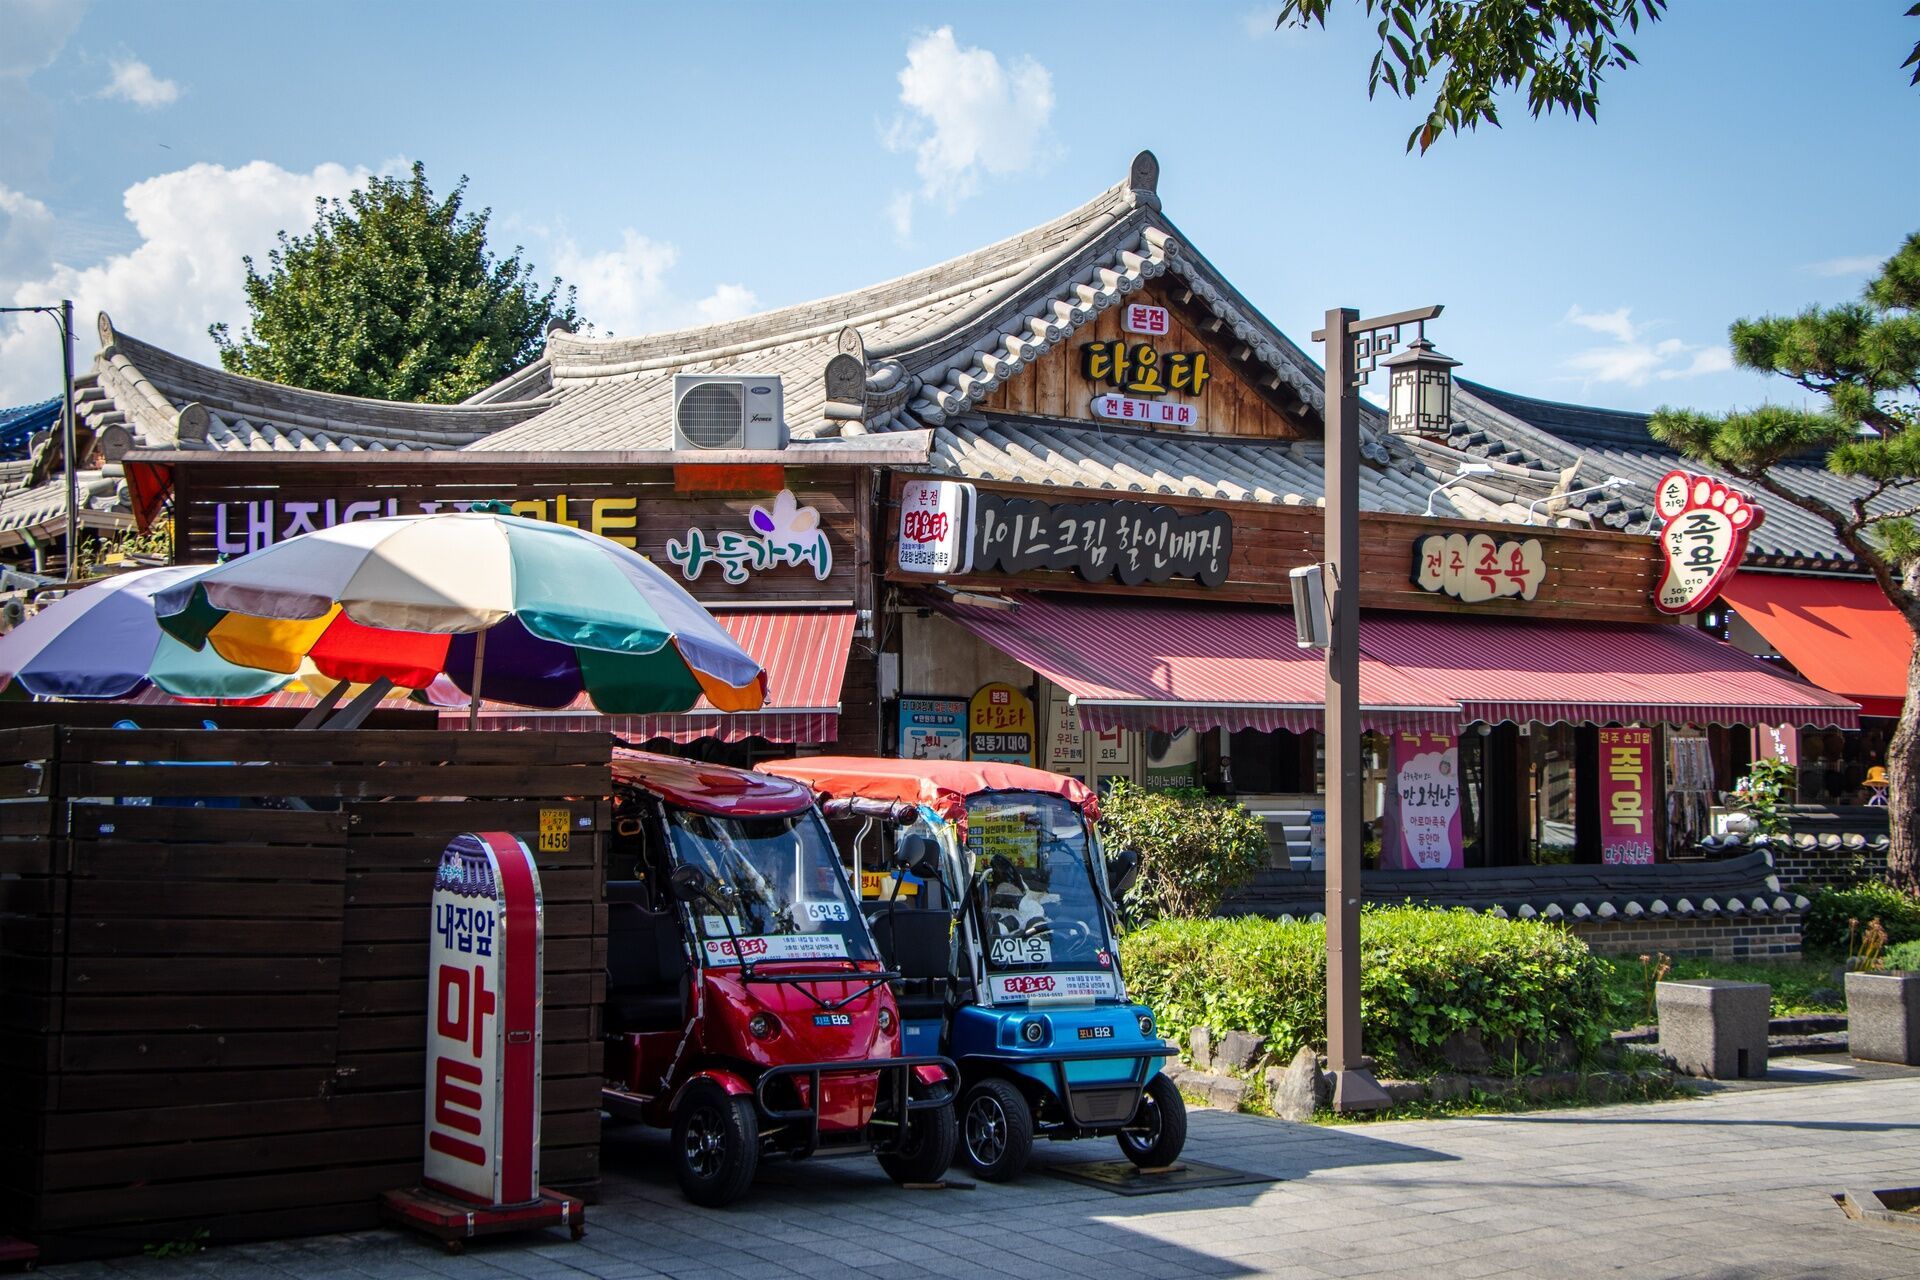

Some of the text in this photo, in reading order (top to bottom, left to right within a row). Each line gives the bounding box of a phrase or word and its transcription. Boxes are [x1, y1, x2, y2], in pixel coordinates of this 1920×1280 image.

[1132, 307, 1164, 331] 본점
[1090, 342, 1210, 394] 타요타
[1106, 399, 1189, 422] 전동기 대여
[919, 489, 938, 506] 본점
[1666, 483, 1679, 499] 손
[1665, 498, 1685, 508] 지압
[904, 510, 949, 543] 타요타
[1115, 515, 1223, 573] 할인매장
[1671, 533, 1683, 557] 전주
[1683, 514, 1722, 577] 족욕
[671, 532, 828, 580] 나들가게
[1427, 543, 1530, 594] 전주 족욕
[1685, 578, 1703, 586] 010
[1671, 587, 1694, 595] 5092
[1663, 596, 1686, 605] 2388
[992, 691, 1008, 703] 본점
[976, 707, 1026, 729] 타요타
[1061, 706, 1076, 717] 나도
[1061, 720, 1076, 731] 너도
[975, 735, 1028, 751] 전동기 대여
[1057, 733, 1080, 745] 우리도
[1600, 732, 1650, 744] 전주 손지압
[1101, 748, 1117, 760] 요타
[1609, 747, 1644, 834] 족욕
[1409, 815, 1447, 828] 아로마족욕
[541, 833, 568, 848] 1458
[1418, 851, 1441, 863] 발지압
[809, 904, 846, 921] 6인용
[436, 903, 495, 957] 내집앞
[706, 942, 718, 952] 43
[720, 938, 767, 957] 타요타
[991, 939, 1046, 963] 4인용
[1099, 953, 1110, 965] 30
[1004, 976, 1056, 994] 타요타
[815, 1014, 850, 1026] 지프 타요
[1094, 1027, 1113, 1038] 타요
[430, 965, 496, 1166] 마트
